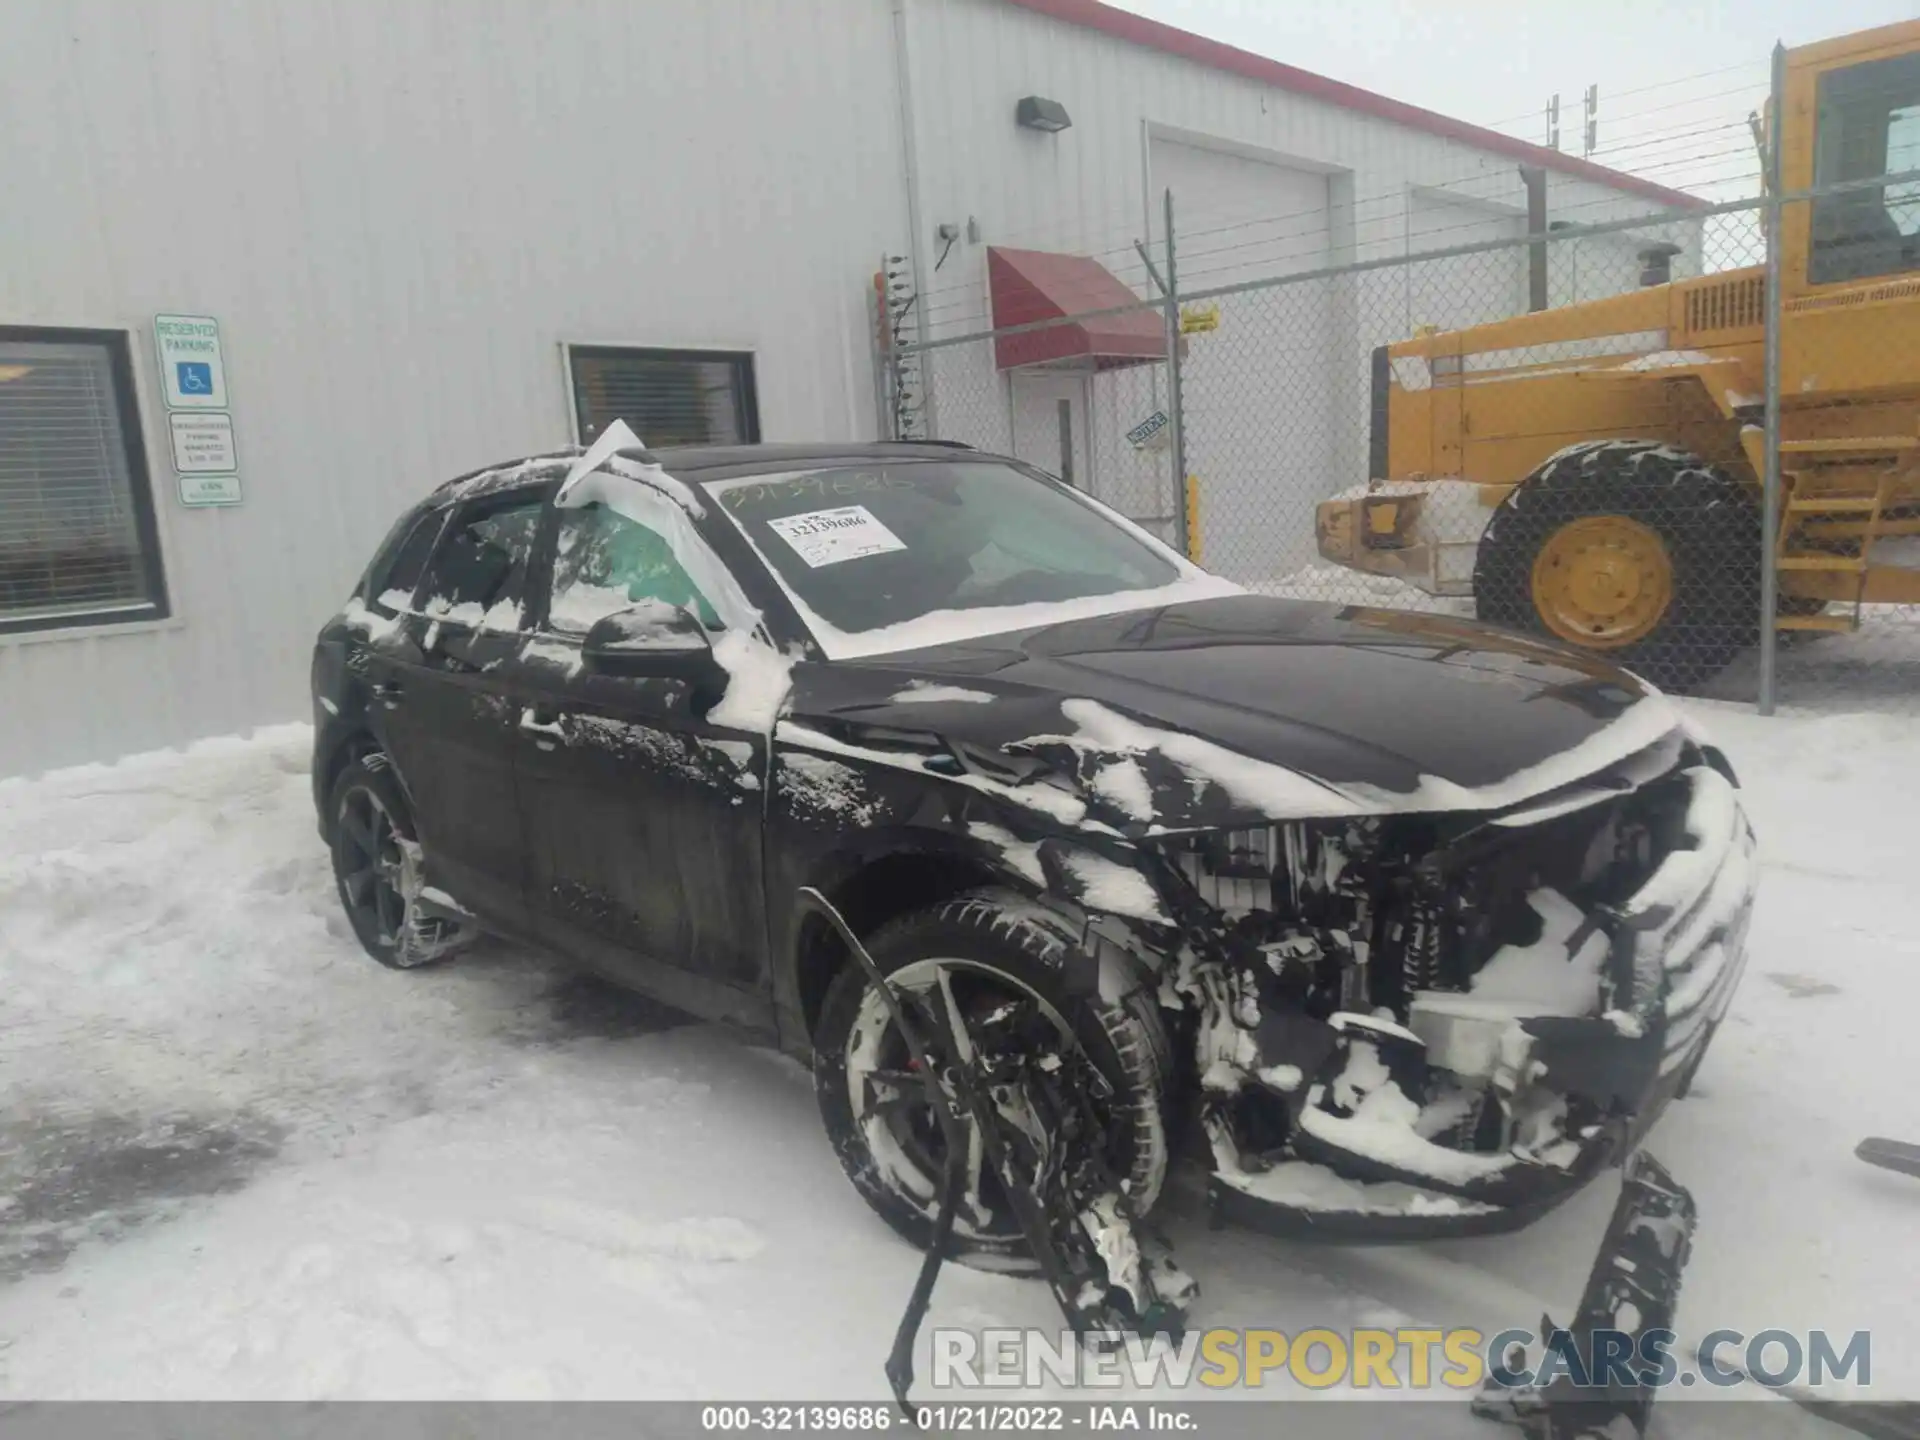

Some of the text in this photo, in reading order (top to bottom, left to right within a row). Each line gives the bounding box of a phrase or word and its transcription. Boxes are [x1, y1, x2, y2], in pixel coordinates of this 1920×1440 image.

[157, 322, 216, 337] RESERVED
[166, 339, 214, 353] PARKING
[790, 515, 868, 538] 32139686
